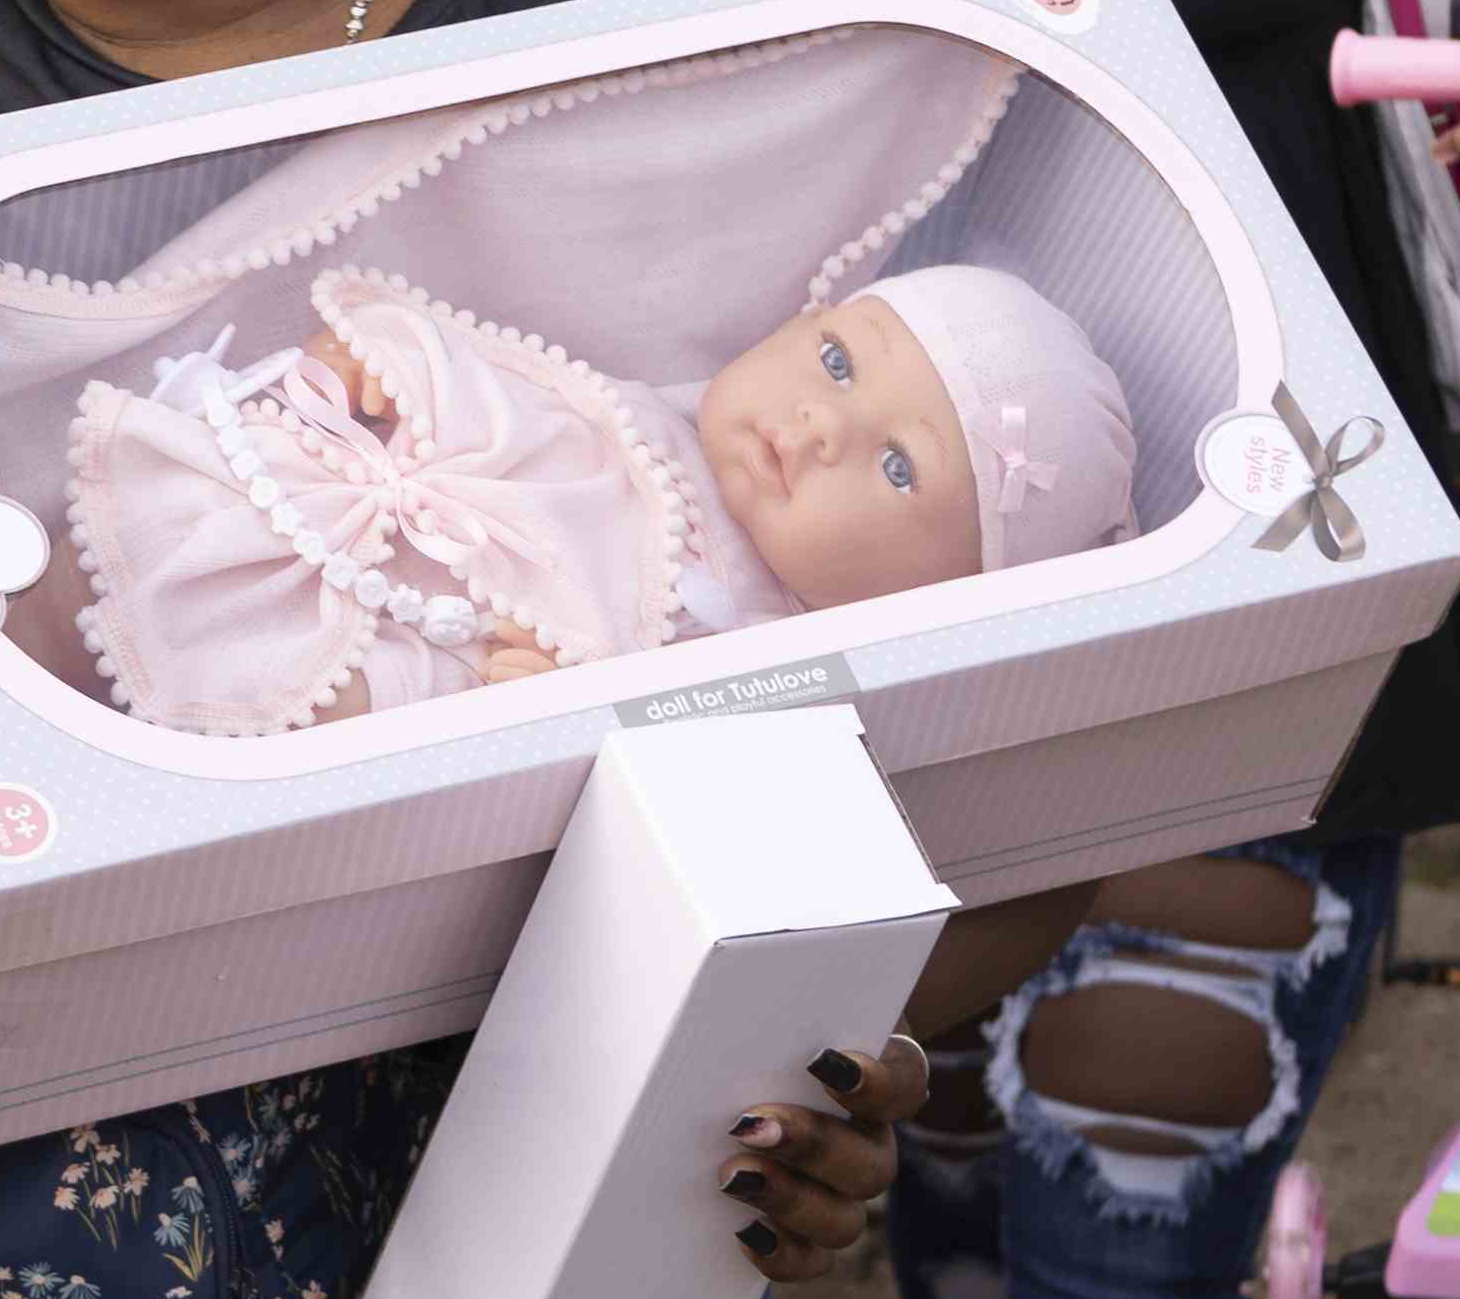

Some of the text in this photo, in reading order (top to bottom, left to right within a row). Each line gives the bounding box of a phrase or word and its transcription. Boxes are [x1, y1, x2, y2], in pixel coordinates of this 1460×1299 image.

[1244, 435, 1267, 495] styles
[1269, 446, 1293, 493] New
[645, 693, 691, 720] doll
[693, 689, 726, 711] for
[729, 667, 828, 700] Tutulove
[5, 803, 38, 839] 3+
